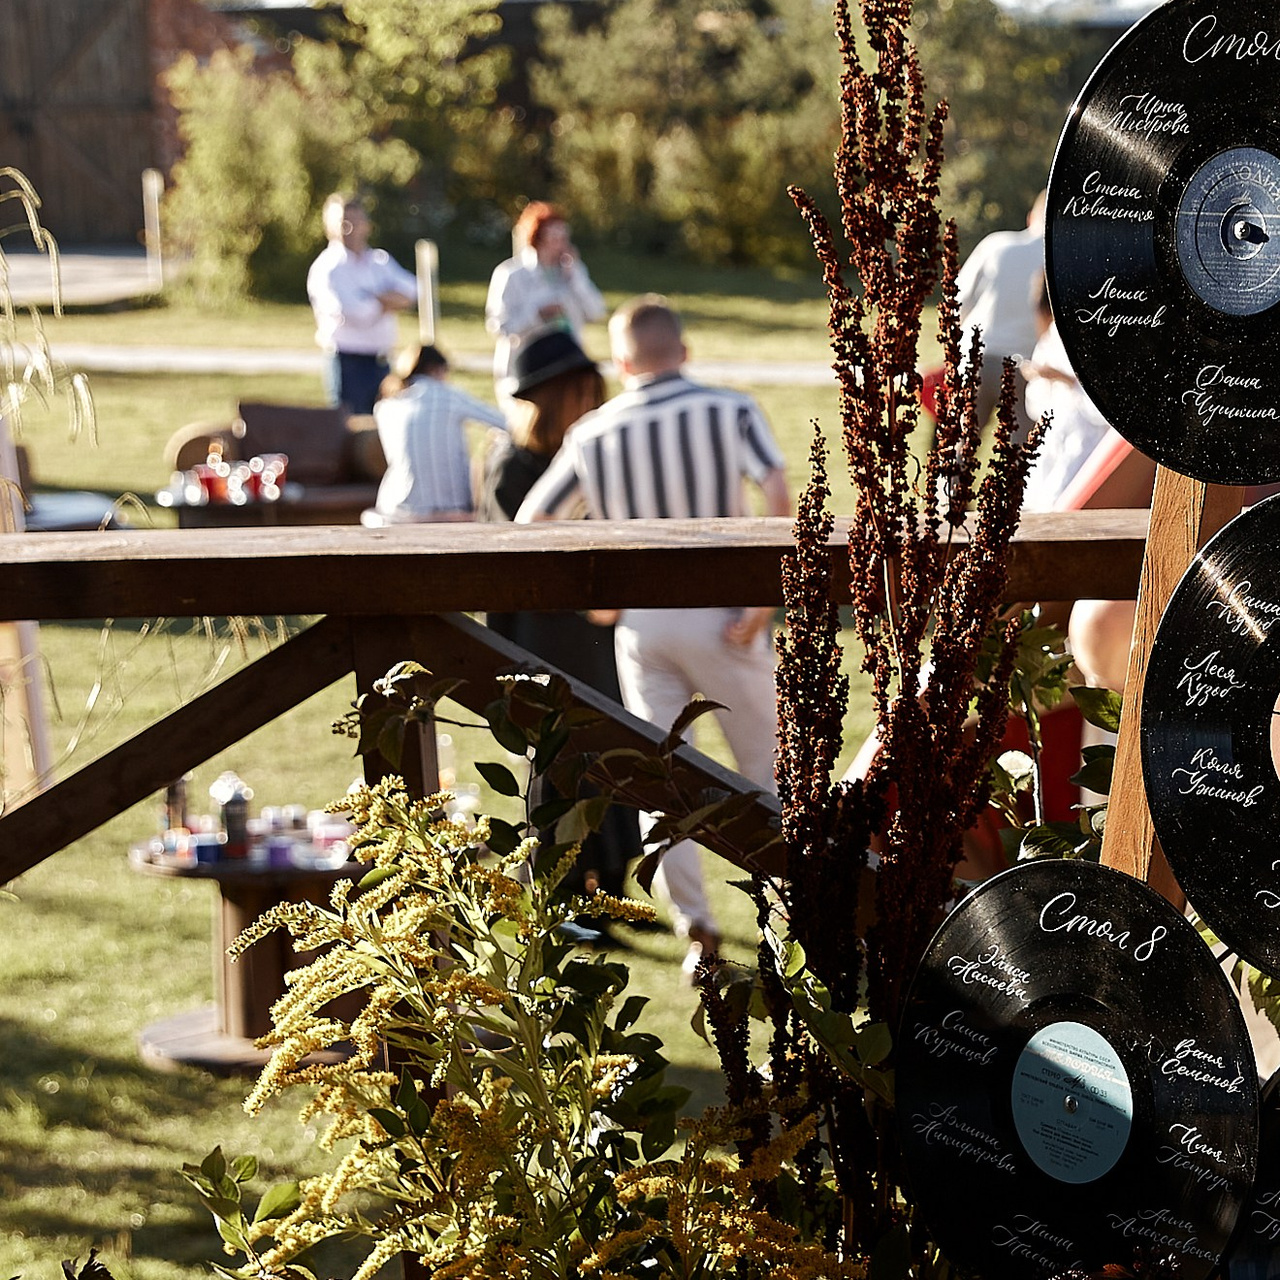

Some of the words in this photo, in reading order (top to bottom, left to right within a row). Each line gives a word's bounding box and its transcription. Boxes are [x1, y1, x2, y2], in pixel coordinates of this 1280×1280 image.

[1063, 195, 1155, 221] Коваленко
[1089, 276, 1148, 301] Леша
[1196, 365, 1262, 390] Даша
[1183, 649, 1241, 686] Леся
[1190, 747, 1244, 779] Коля
[1171, 768, 1265, 808] Ужинов
[1038, 892, 1131, 950] Стол
[1134, 926, 1167, 962] 8
[1175, 1039, 1225, 1070] Ваня
[1161, 1058, 1244, 1093] Семенов
[1168, 1123, 1227, 1164] Илья
